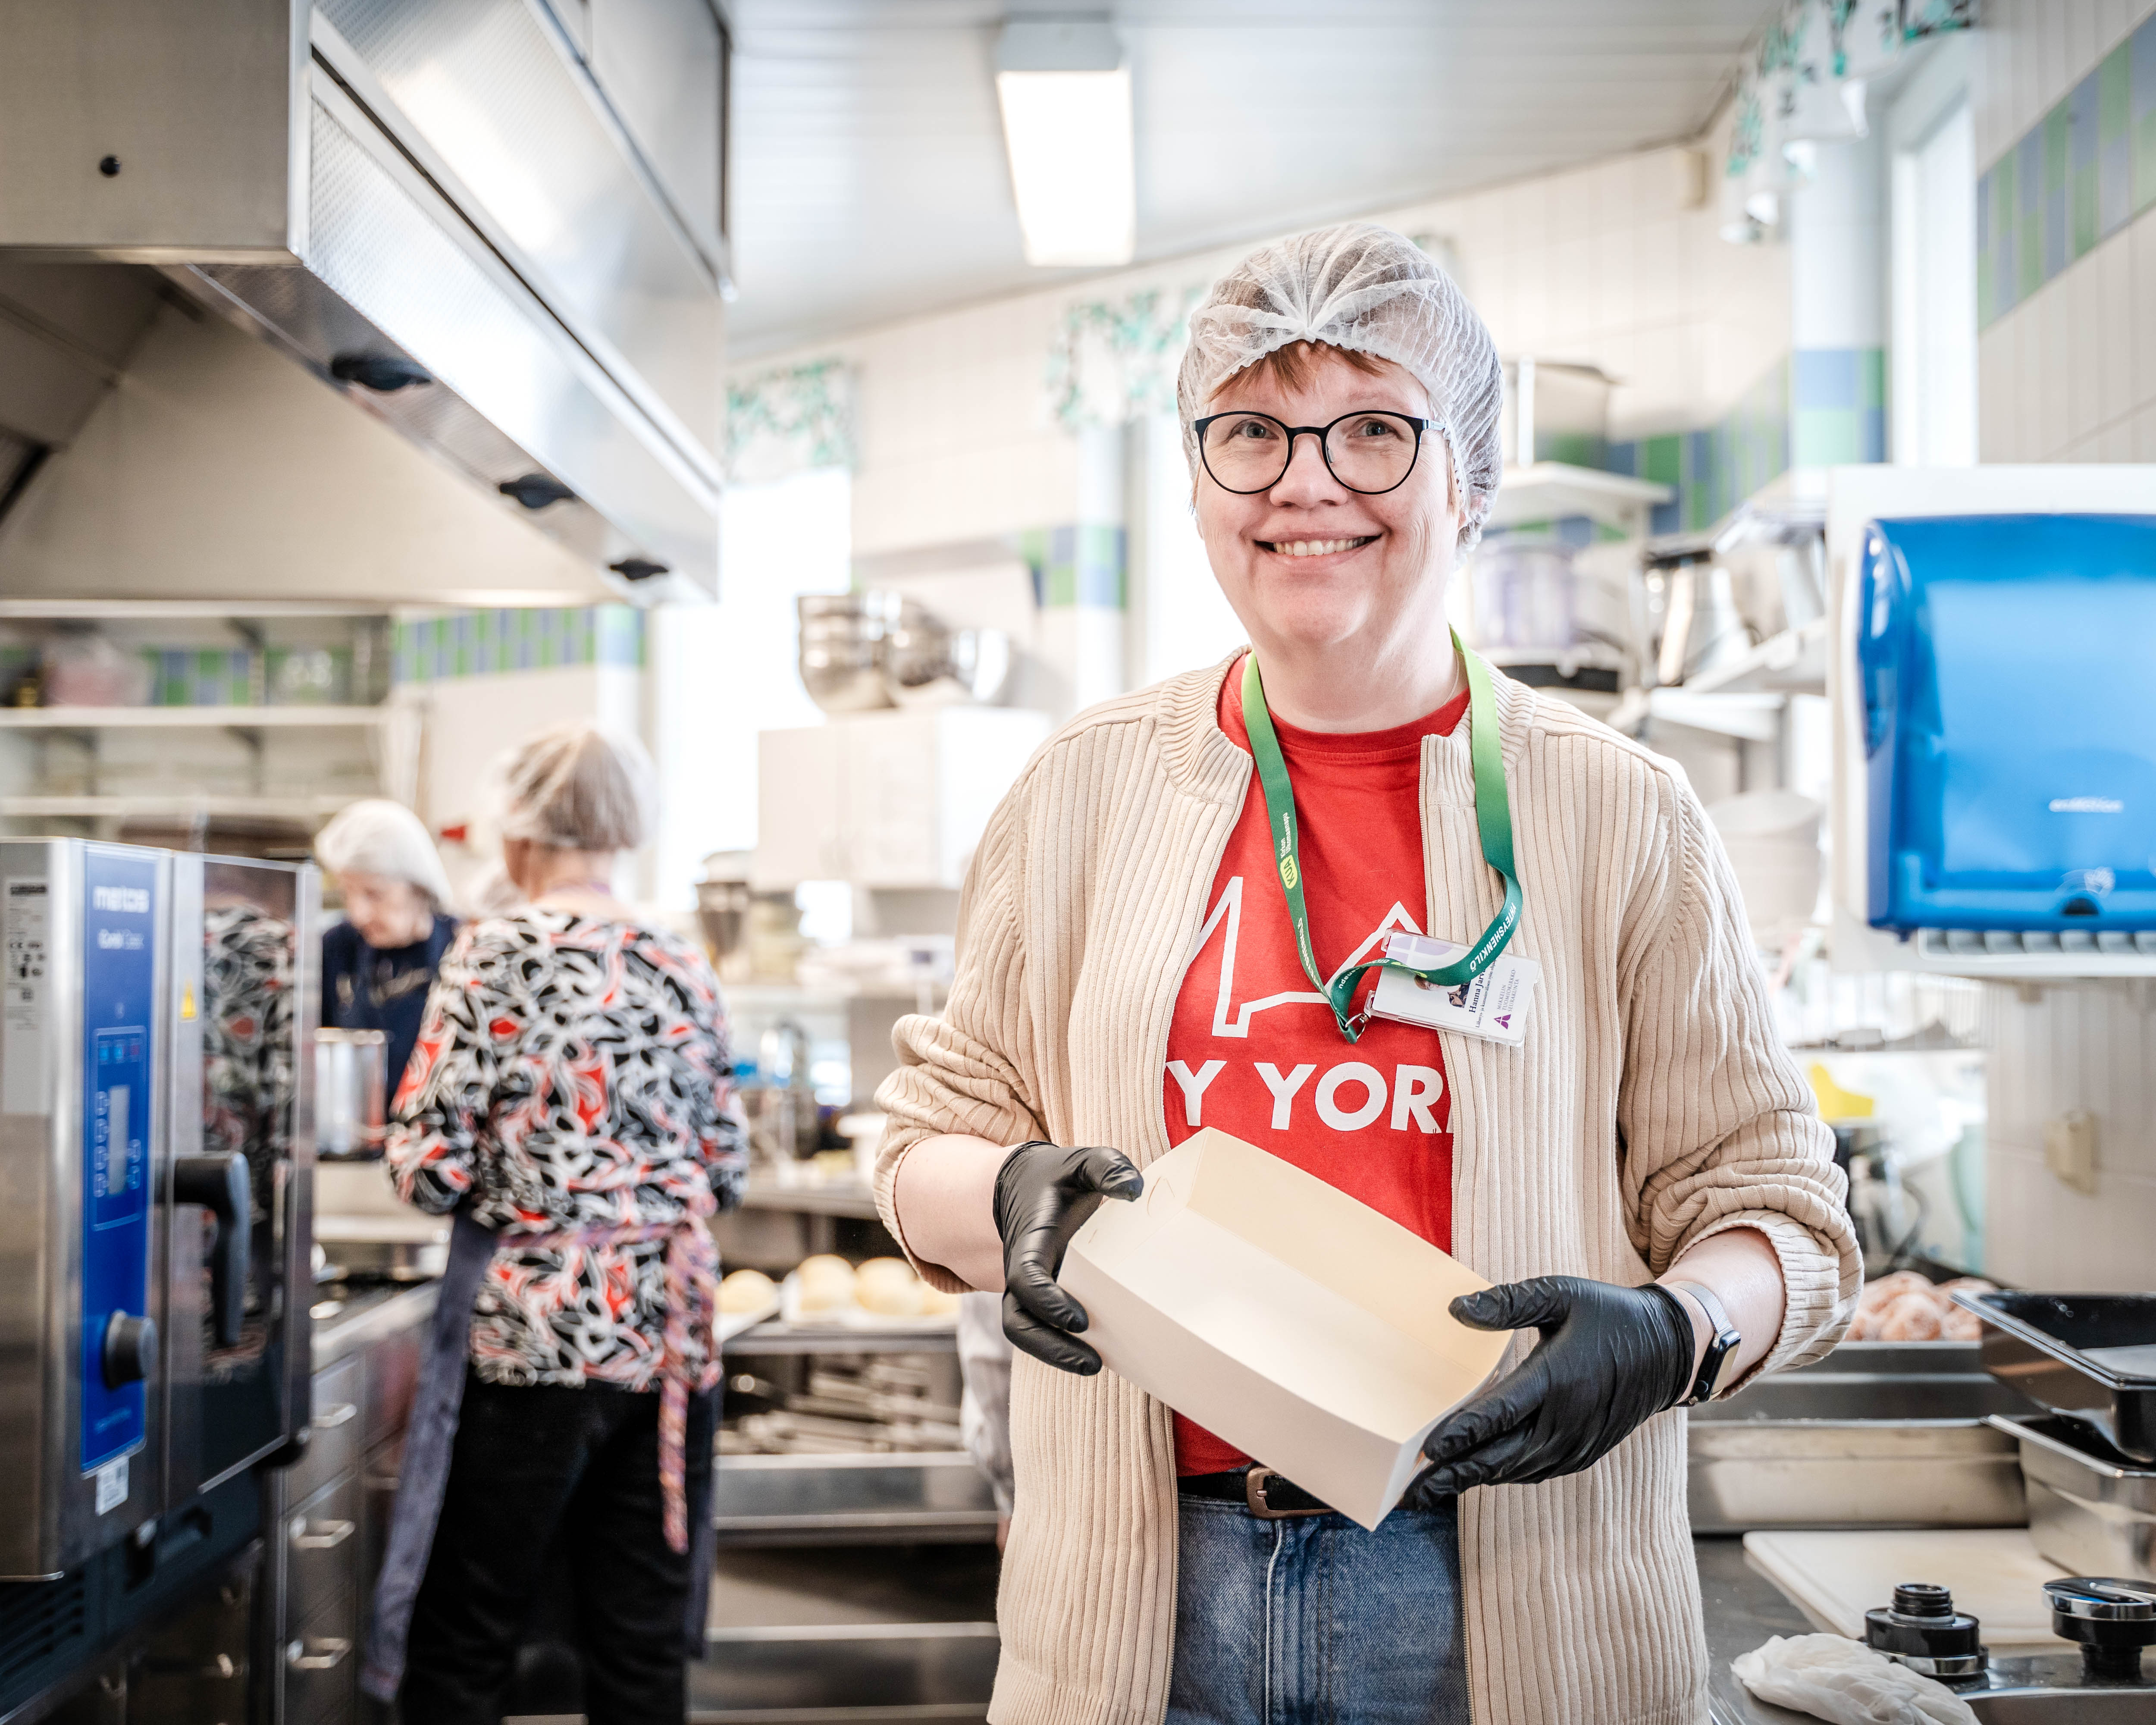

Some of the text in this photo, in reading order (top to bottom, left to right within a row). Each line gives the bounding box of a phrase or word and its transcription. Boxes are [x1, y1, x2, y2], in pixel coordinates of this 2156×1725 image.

[1283, 812, 1291, 854] Ulkomaanapu
[1284, 859, 1294, 885] KUA
[1470, 902, 1517, 972] YHTEYSHENKILÖ
[1469, 988, 1481, 1013] Hanna
[1497, 985, 1506, 1010] MIKKELIN
[1502, 968, 1516, 1010] TUOMIOKIRKKO-
[1508, 979, 1520, 1012] SEURAKUNTA
[1253, 1061, 1454, 1134] YOR
